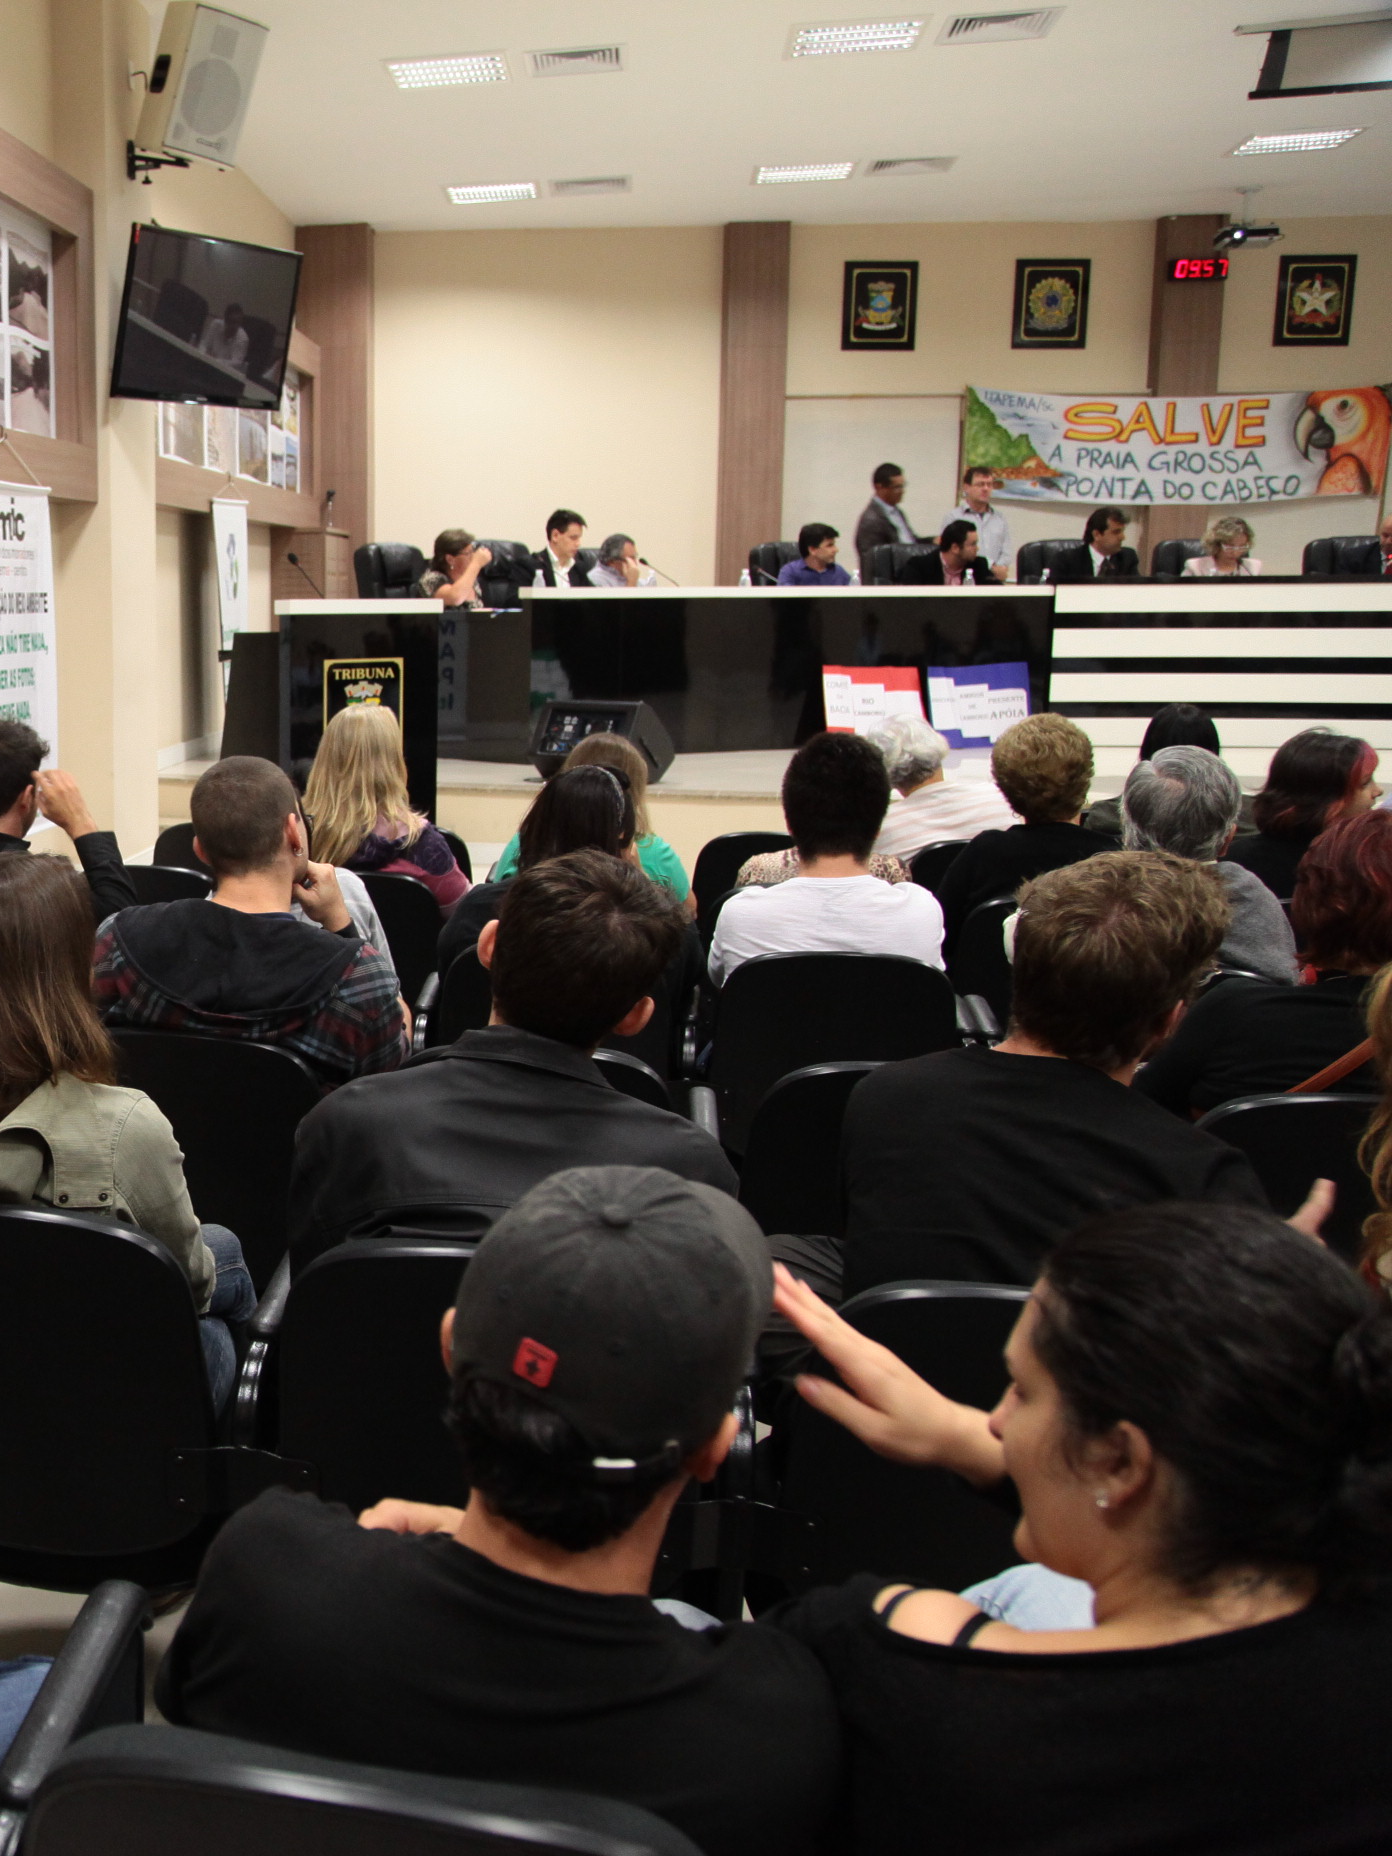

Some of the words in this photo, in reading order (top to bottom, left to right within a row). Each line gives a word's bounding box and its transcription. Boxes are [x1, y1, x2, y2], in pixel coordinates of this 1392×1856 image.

[1063, 398, 1270, 449] SALVE
[1048, 444, 1063, 463] A
[1076, 447, 1141, 473] PRAIA
[1147, 449, 1263, 475] GROSSA
[1064, 473, 1155, 502] PONTA
[1162, 479, 1195, 501] DO
[332, 667, 395, 681] TRIBUNA
